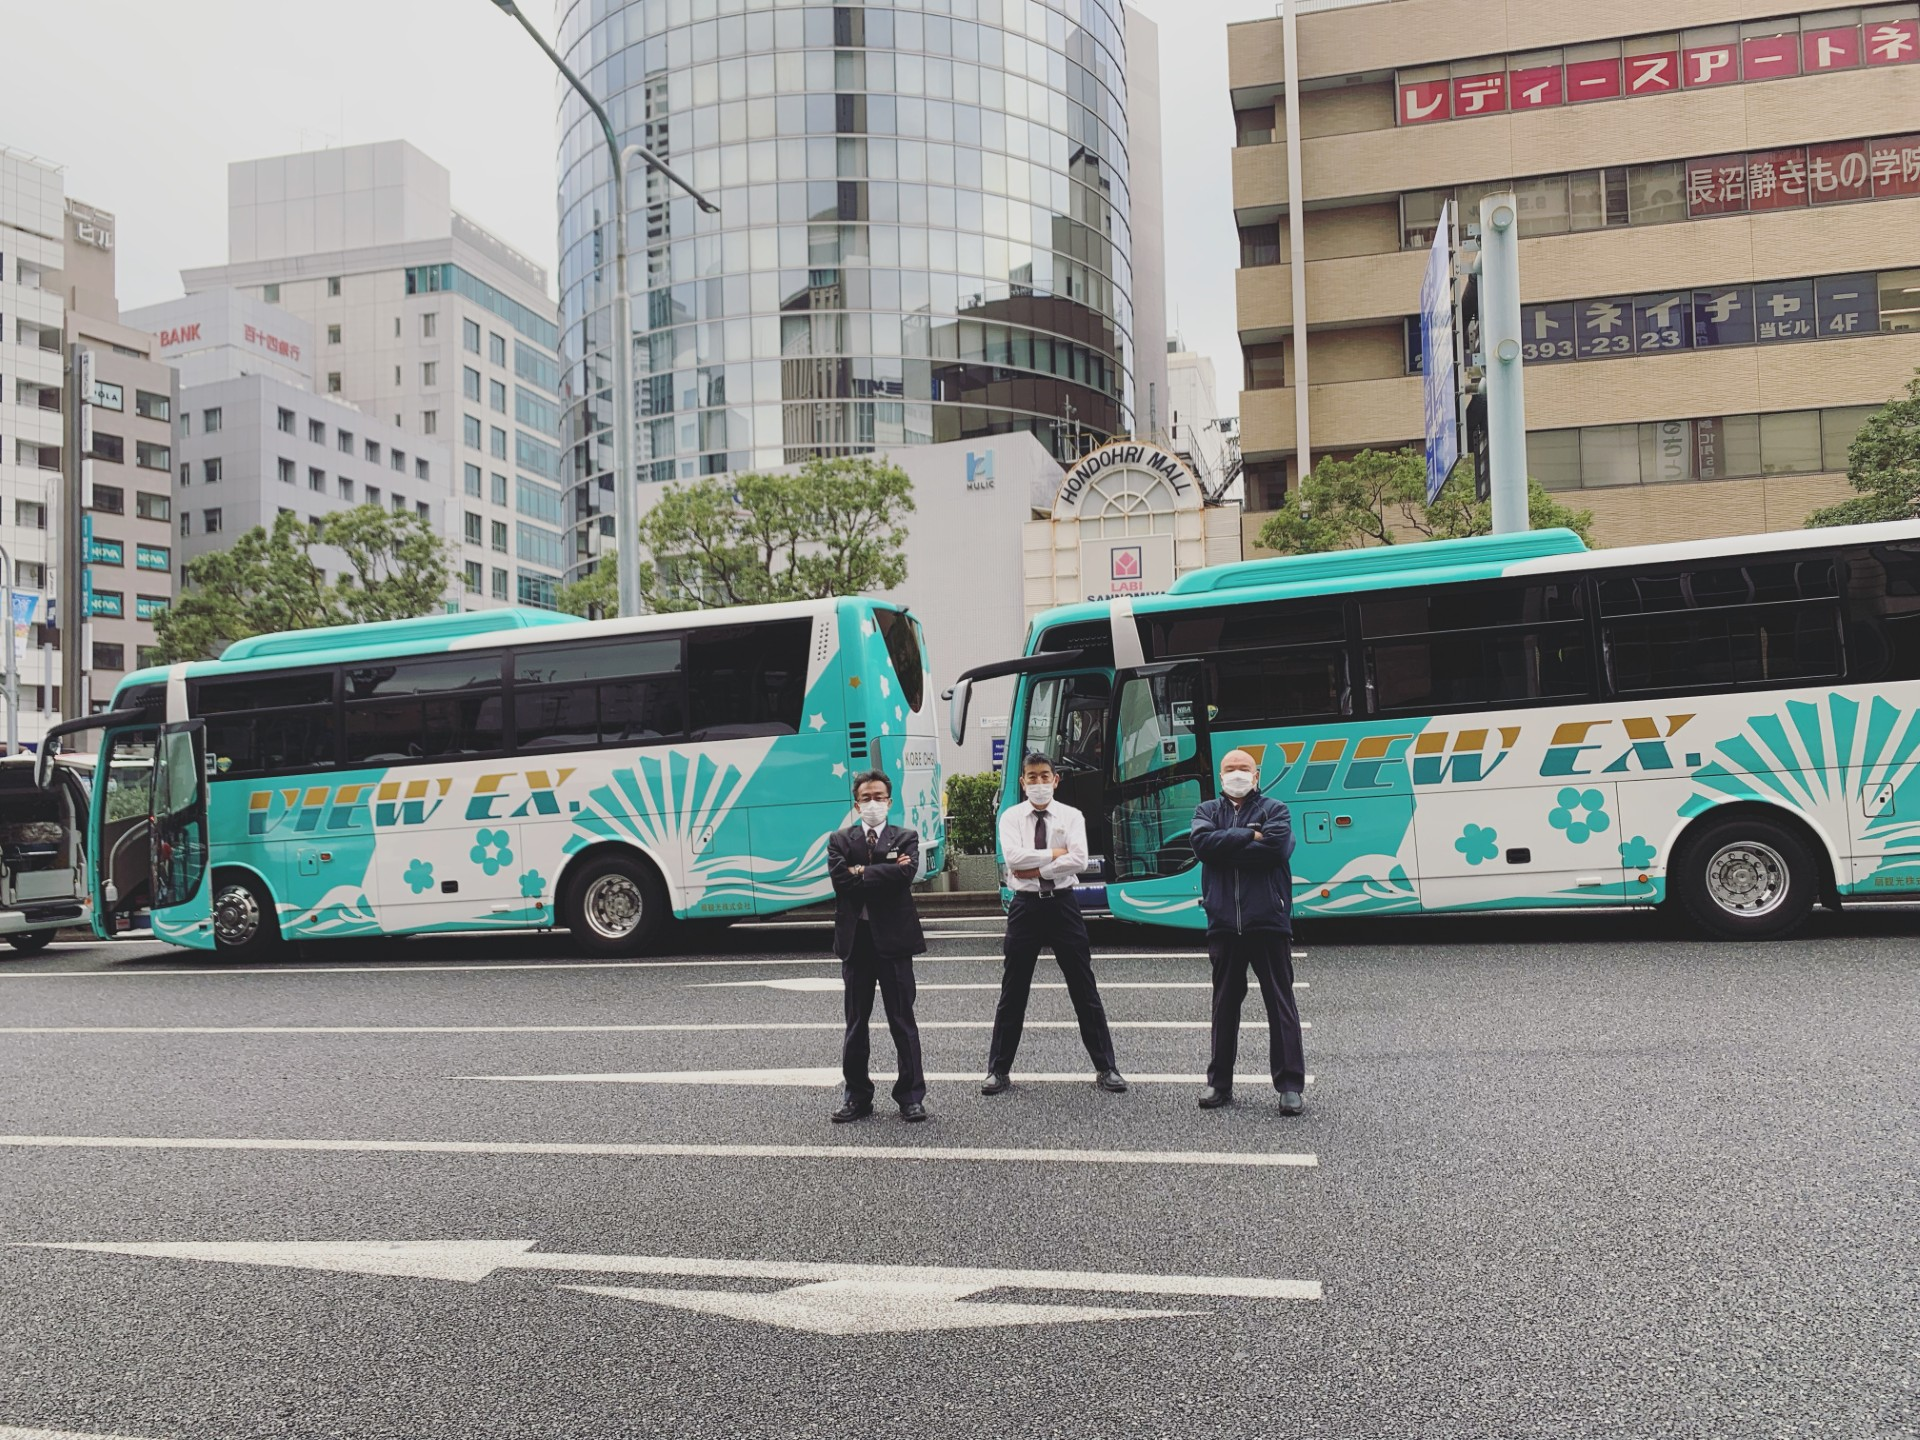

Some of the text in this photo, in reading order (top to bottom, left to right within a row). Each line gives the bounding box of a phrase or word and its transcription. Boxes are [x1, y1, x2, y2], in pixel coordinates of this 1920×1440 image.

[1406, 27, 1912, 119] レディースアートネ
[1760, 312, 1859, 339] 当ビル 4F
[160, 323, 201, 347] BANK
[244, 324, 300, 362] 百十四銀行
[94, 391, 118, 402] OLA
[1061, 446, 1191, 505] HONDOHRI MALL
[966, 481, 994, 491] HULIC
[92, 548, 120, 560] NOVA
[138, 552, 165, 565] NOVA
[1111, 581, 1143, 592] LABI
[91, 599, 118, 610] NOVA
[905, 752, 922, 766] KOBE
[248, 777, 453, 836] VIEW
